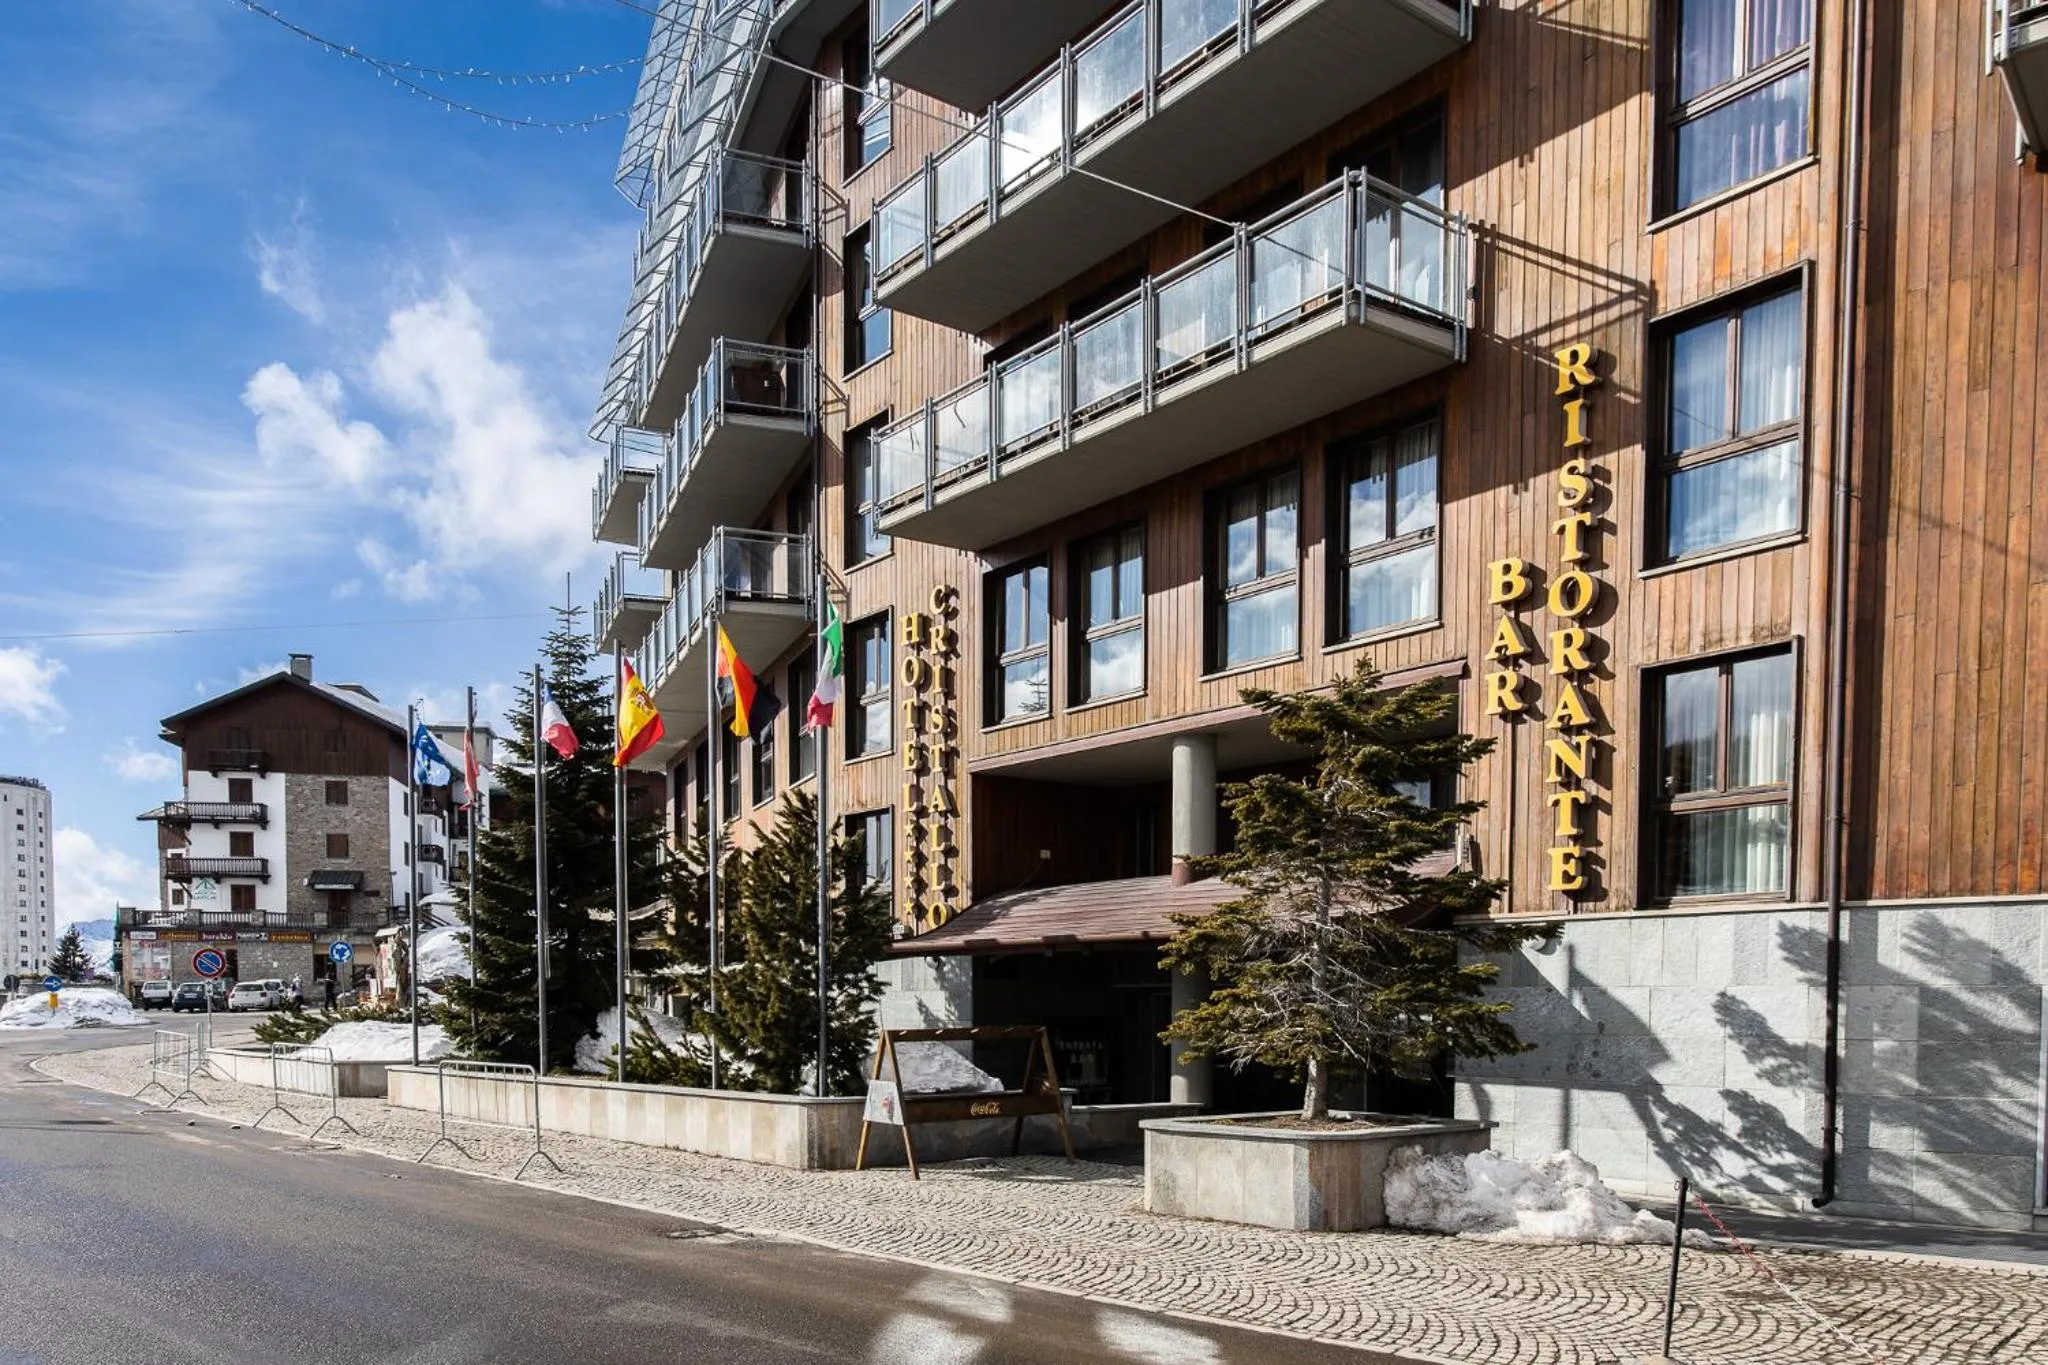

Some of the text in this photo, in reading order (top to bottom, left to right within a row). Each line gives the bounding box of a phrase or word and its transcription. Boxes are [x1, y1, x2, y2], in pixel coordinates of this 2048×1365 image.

[900, 612, 922, 813] HOTEL
[1485, 556, 1534, 717] BAR
[1547, 342, 1601, 893] RISTORANTE
[927, 584, 950, 929] CRISTALLO
